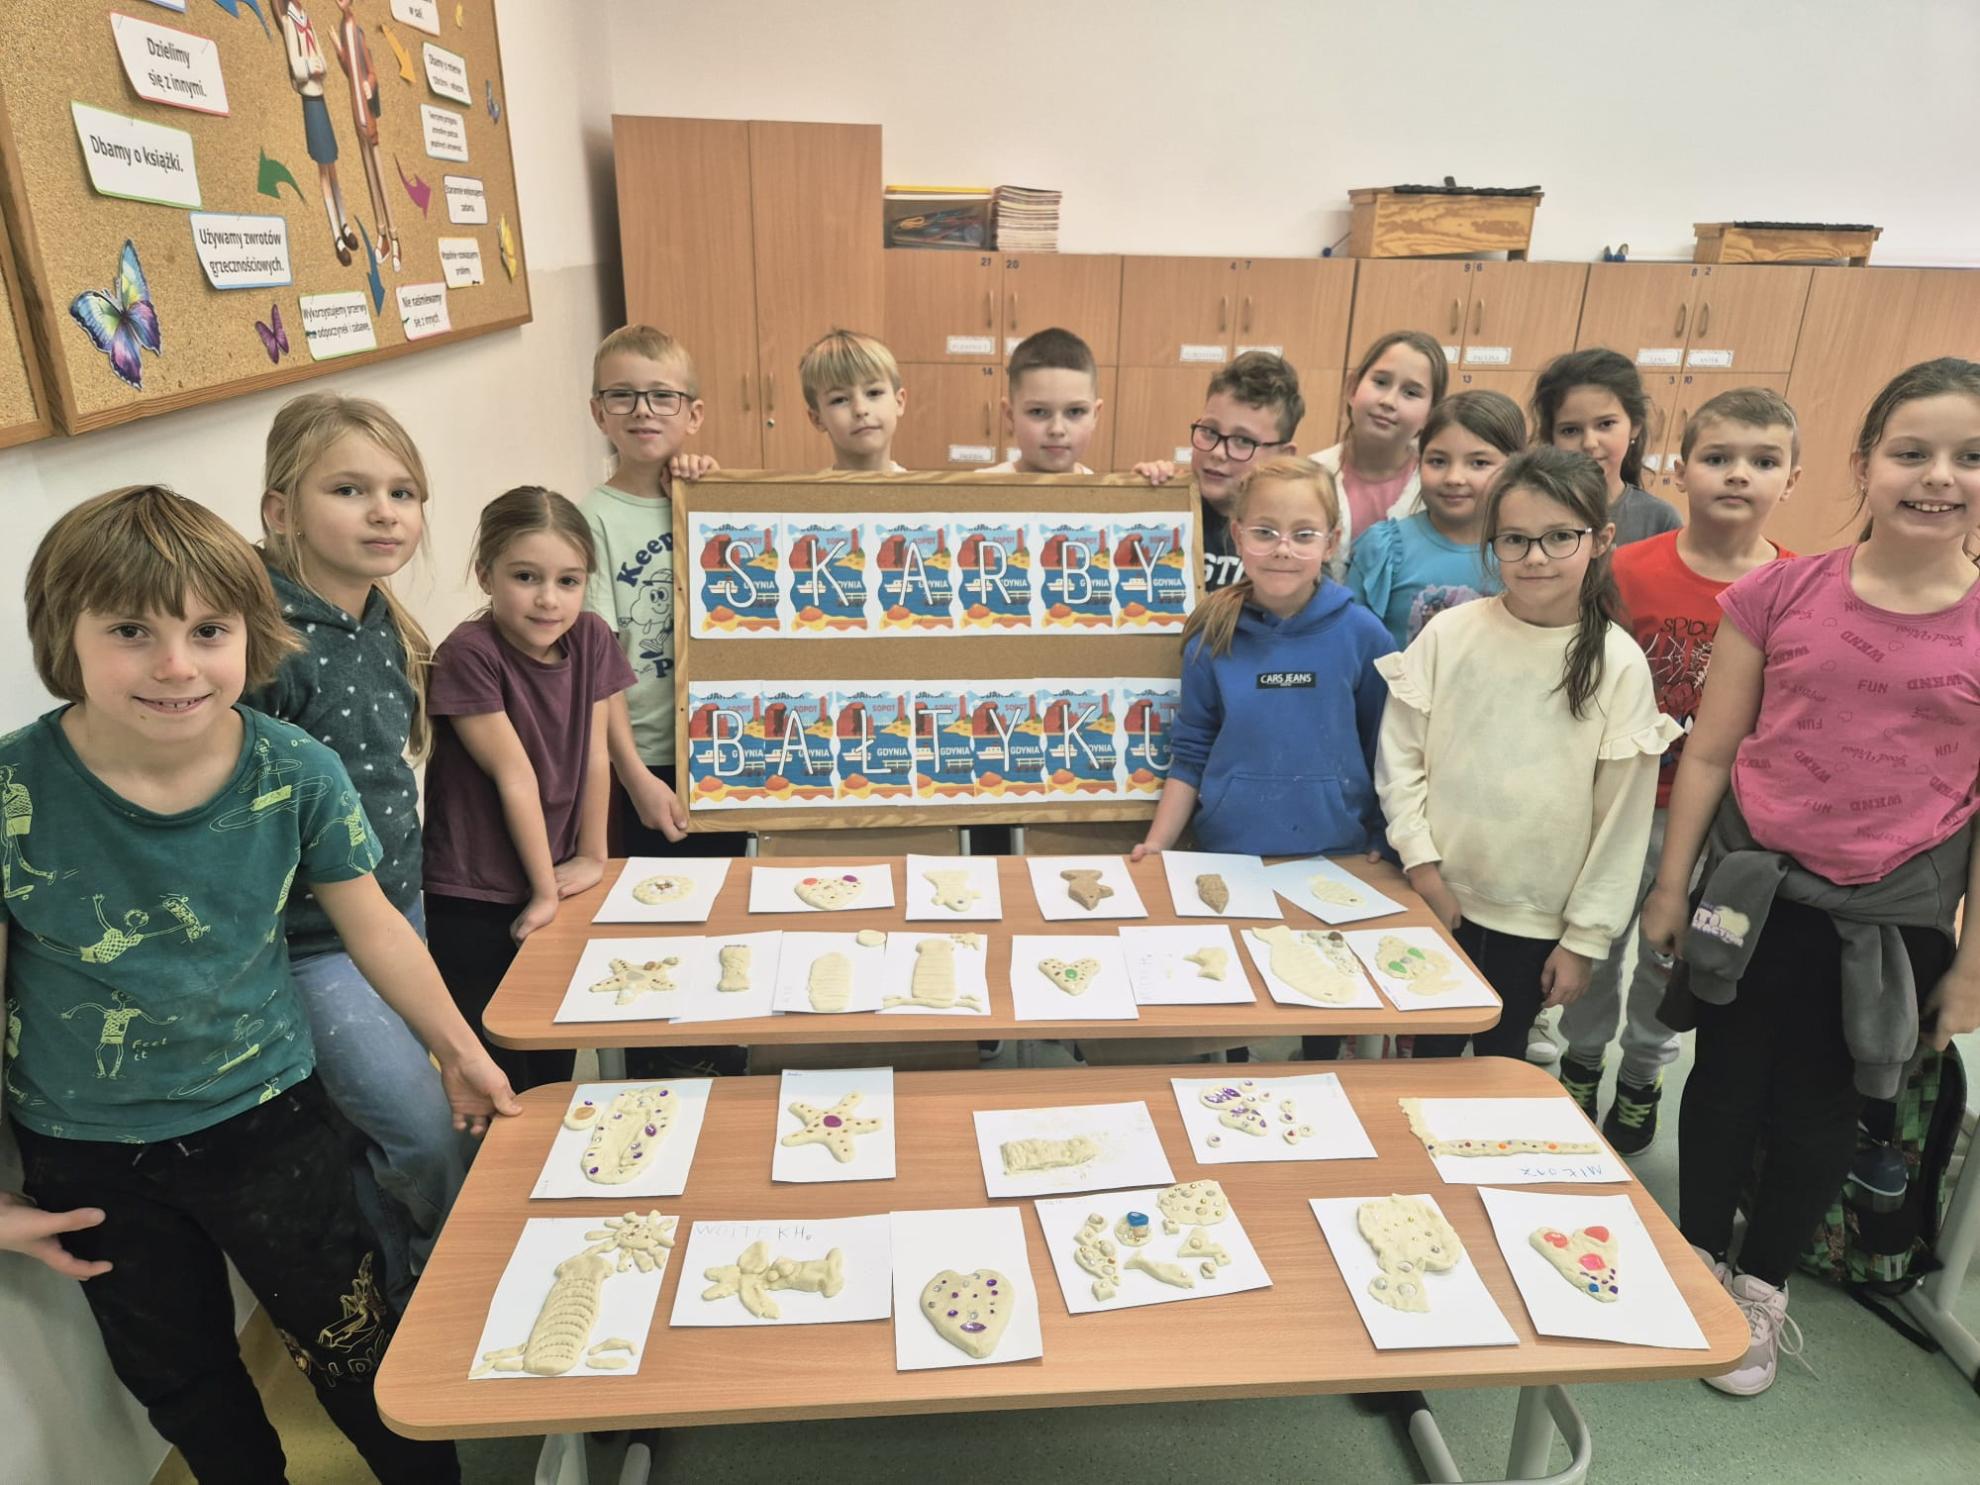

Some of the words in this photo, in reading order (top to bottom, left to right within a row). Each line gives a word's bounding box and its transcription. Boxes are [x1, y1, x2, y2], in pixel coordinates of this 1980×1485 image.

[146, 37, 190, 69] Dzielimy
[148, 69, 165, 92] się
[164, 77, 172, 90] z
[170, 73, 208, 99] innymi.
[89, 134, 132, 166] Dbamy
[134, 148, 142, 163] o
[142, 146, 184, 173] książki.
[199, 225, 244, 249] Używamy
[243, 229, 281, 246] zwrotów
[209, 256, 284, 278] grzecznościowych.
[981, 257, 992, 267] 21
[616, 532, 674, 588] Keep
[725, 540, 1165, 608] SKARBY
[743, 580, 776, 590] GYNIA
[1001, 578, 1028, 588] DYNIA
[1079, 578, 1110, 588] GYNIA
[1153, 578, 1183, 587] GDYNIA
[1260, 674, 1284, 684] CARS
[1284, 673, 1312, 684] JEANS
[1857, 679, 1888, 695] FUN
[1797, 718, 1823, 731] FUN
[731, 749, 765, 758] GYNIA
[876, 747, 908, 756] GDYNIA
[940, 746, 970, 755] GDYNIA
[1010, 745, 1040, 754] GDYNIA
[1803, 799, 1832, 815] FUN
